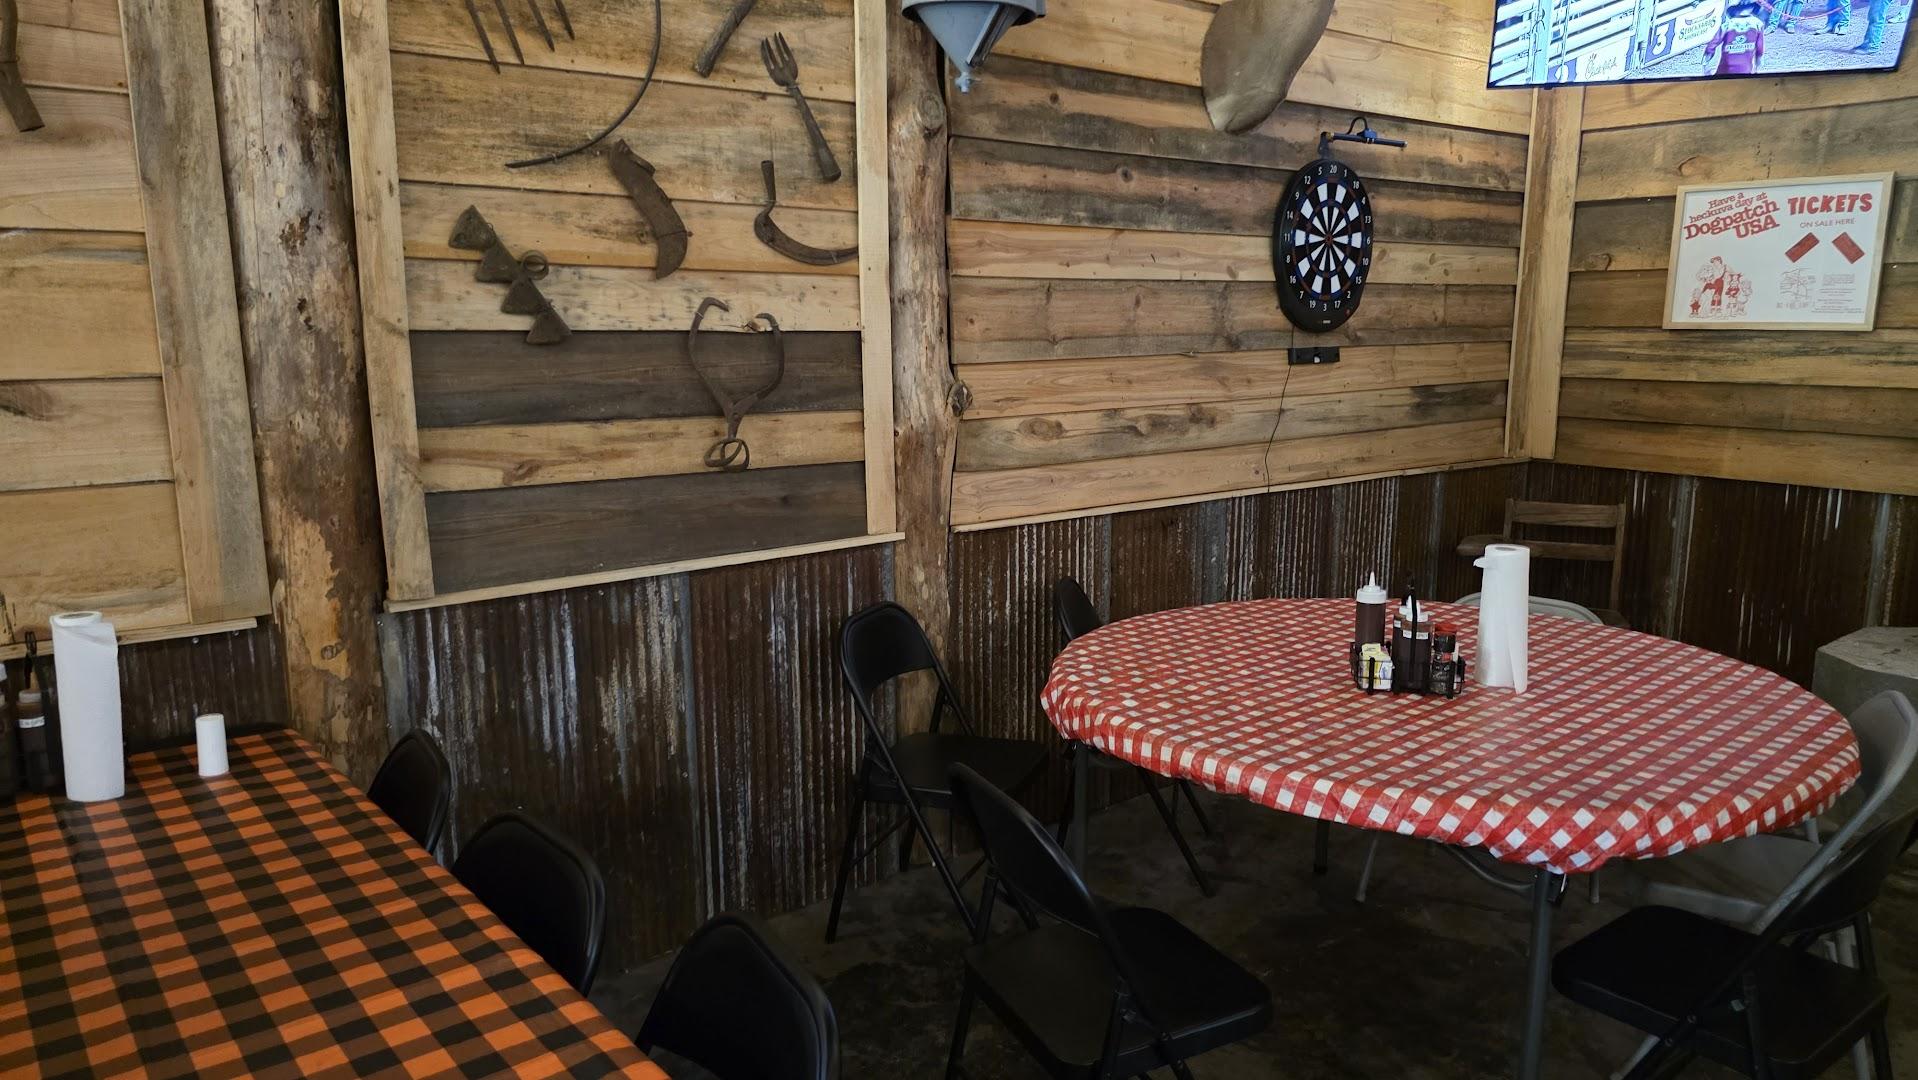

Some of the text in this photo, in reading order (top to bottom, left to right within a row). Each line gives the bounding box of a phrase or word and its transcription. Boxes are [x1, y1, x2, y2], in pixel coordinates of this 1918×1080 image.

[1652, 22, 1669, 55] 3
[1329, 165, 1338, 173] 20
[1304, 176, 1312, 184] 12
[1353, 181, 1360, 189] 18
[1708, 194, 1735, 209] Have
[1735, 196, 1754, 208] day
[1756, 192, 1768, 201] at
[1788, 193, 1874, 216] TICKETS
[1286, 211, 1294, 219] 14
[1684, 200, 1780, 239] Dogpatch
[1732, 215, 1780, 238] USA
[1800, 217, 1856, 228] ON SALE HERE
[1284, 233, 1291, 241] 11
[1355, 276, 1362, 284] 15
[1309, 300, 1317, 308] 19
